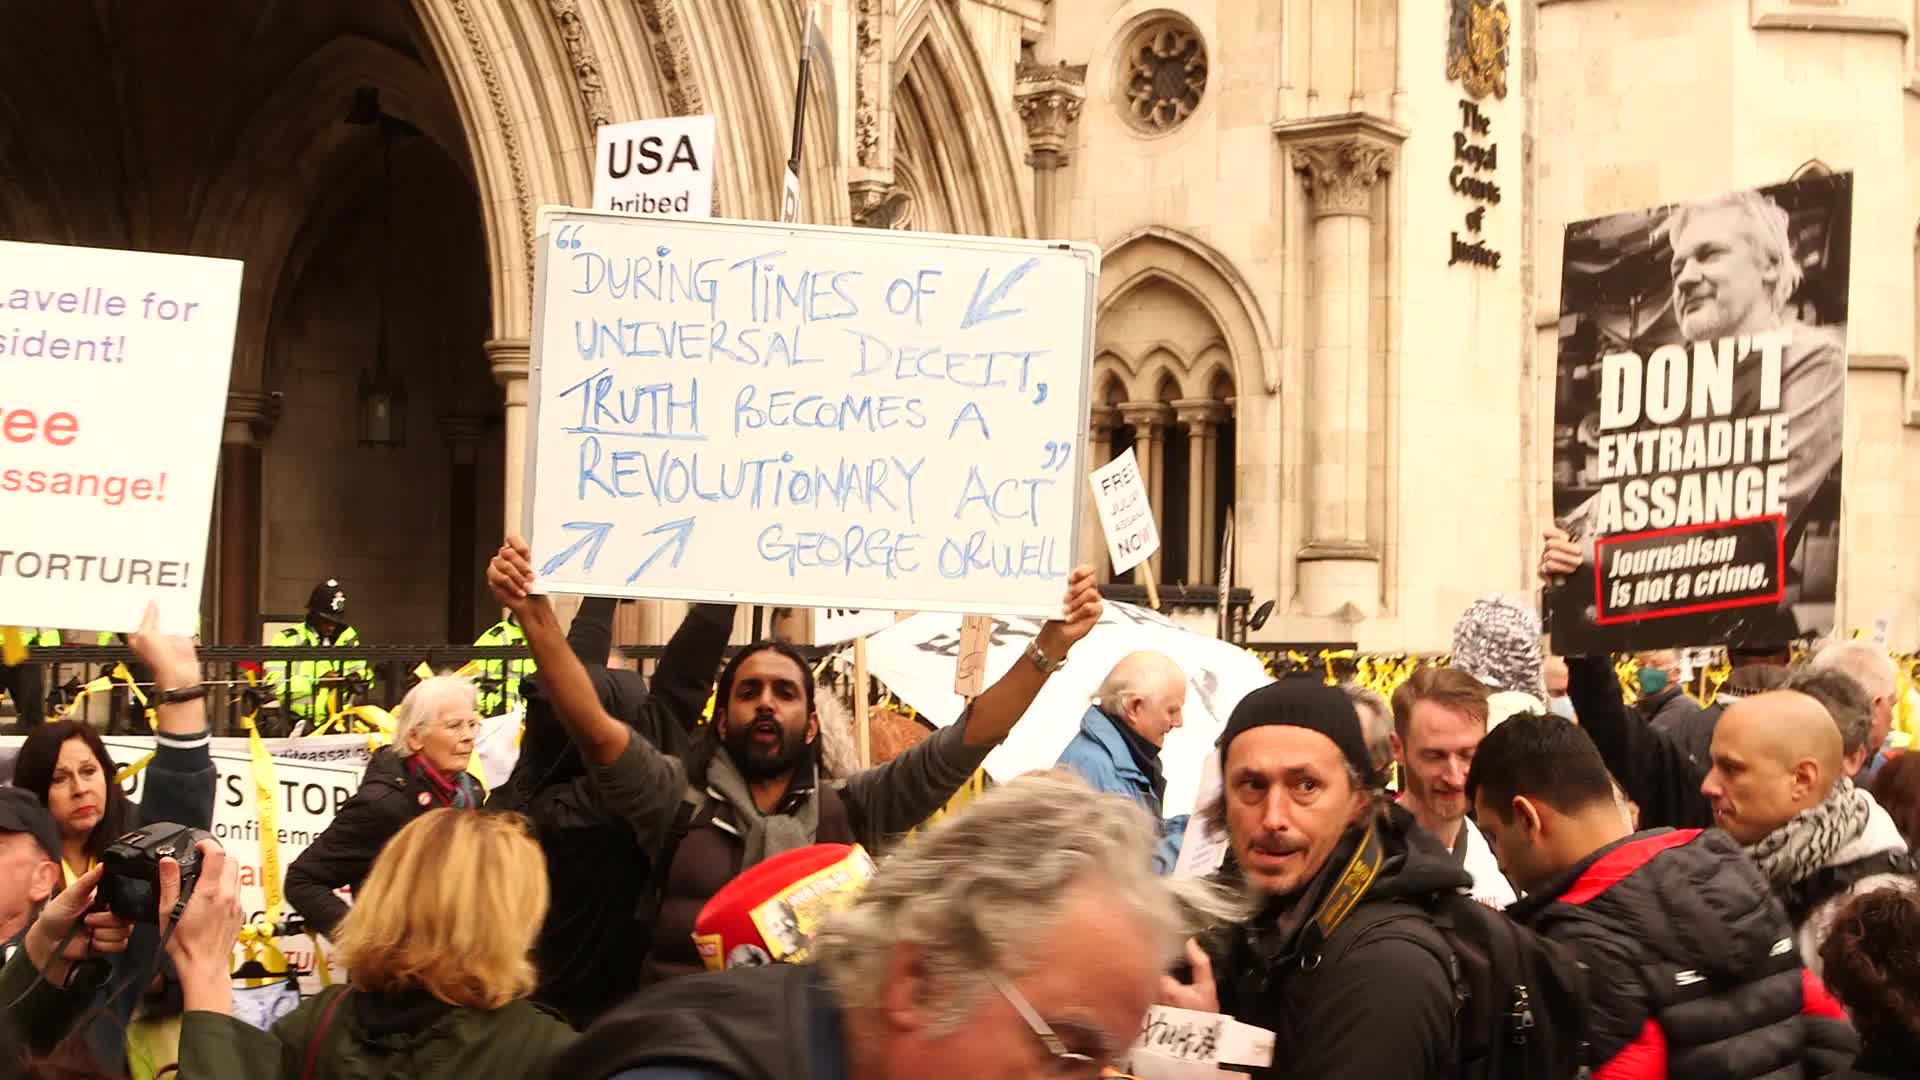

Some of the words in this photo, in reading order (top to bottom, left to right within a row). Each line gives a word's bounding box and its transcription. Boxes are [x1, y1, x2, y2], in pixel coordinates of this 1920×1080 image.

[1459, 99, 1491, 136] The
[608, 134, 699, 179] USA
[1453, 131, 1497, 173] Royal
[1465, 206, 1486, 234] of
[1448, 231, 1502, 271] Justice
[0, 287, 127, 316] avelle
[141, 292, 200, 322] for
[885, 269, 943, 327] OF
[575, 317, 825, 368] UNIVERSAL
[557, 367, 699, 435] TRUTH
[735, 384, 927, 438] BECOMES
[948, 402, 991, 440] A
[1600, 333, 1793, 430] DON'T
[0, 408, 80, 446] ee
[1599, 412, 1790, 481] EXTRADITE
[1600, 462, 1788, 536] ASSANGE
[0, 550, 190, 589] TORTURE!
[757, 523, 927, 579] GEORGE
[938, 530, 1067, 578] ORWELL
[1609, 577, 1633, 609] is
[1634, 572, 1673, 603] not
[1675, 575, 1692, 600] a
[1694, 562, 1769, 599] crime.
